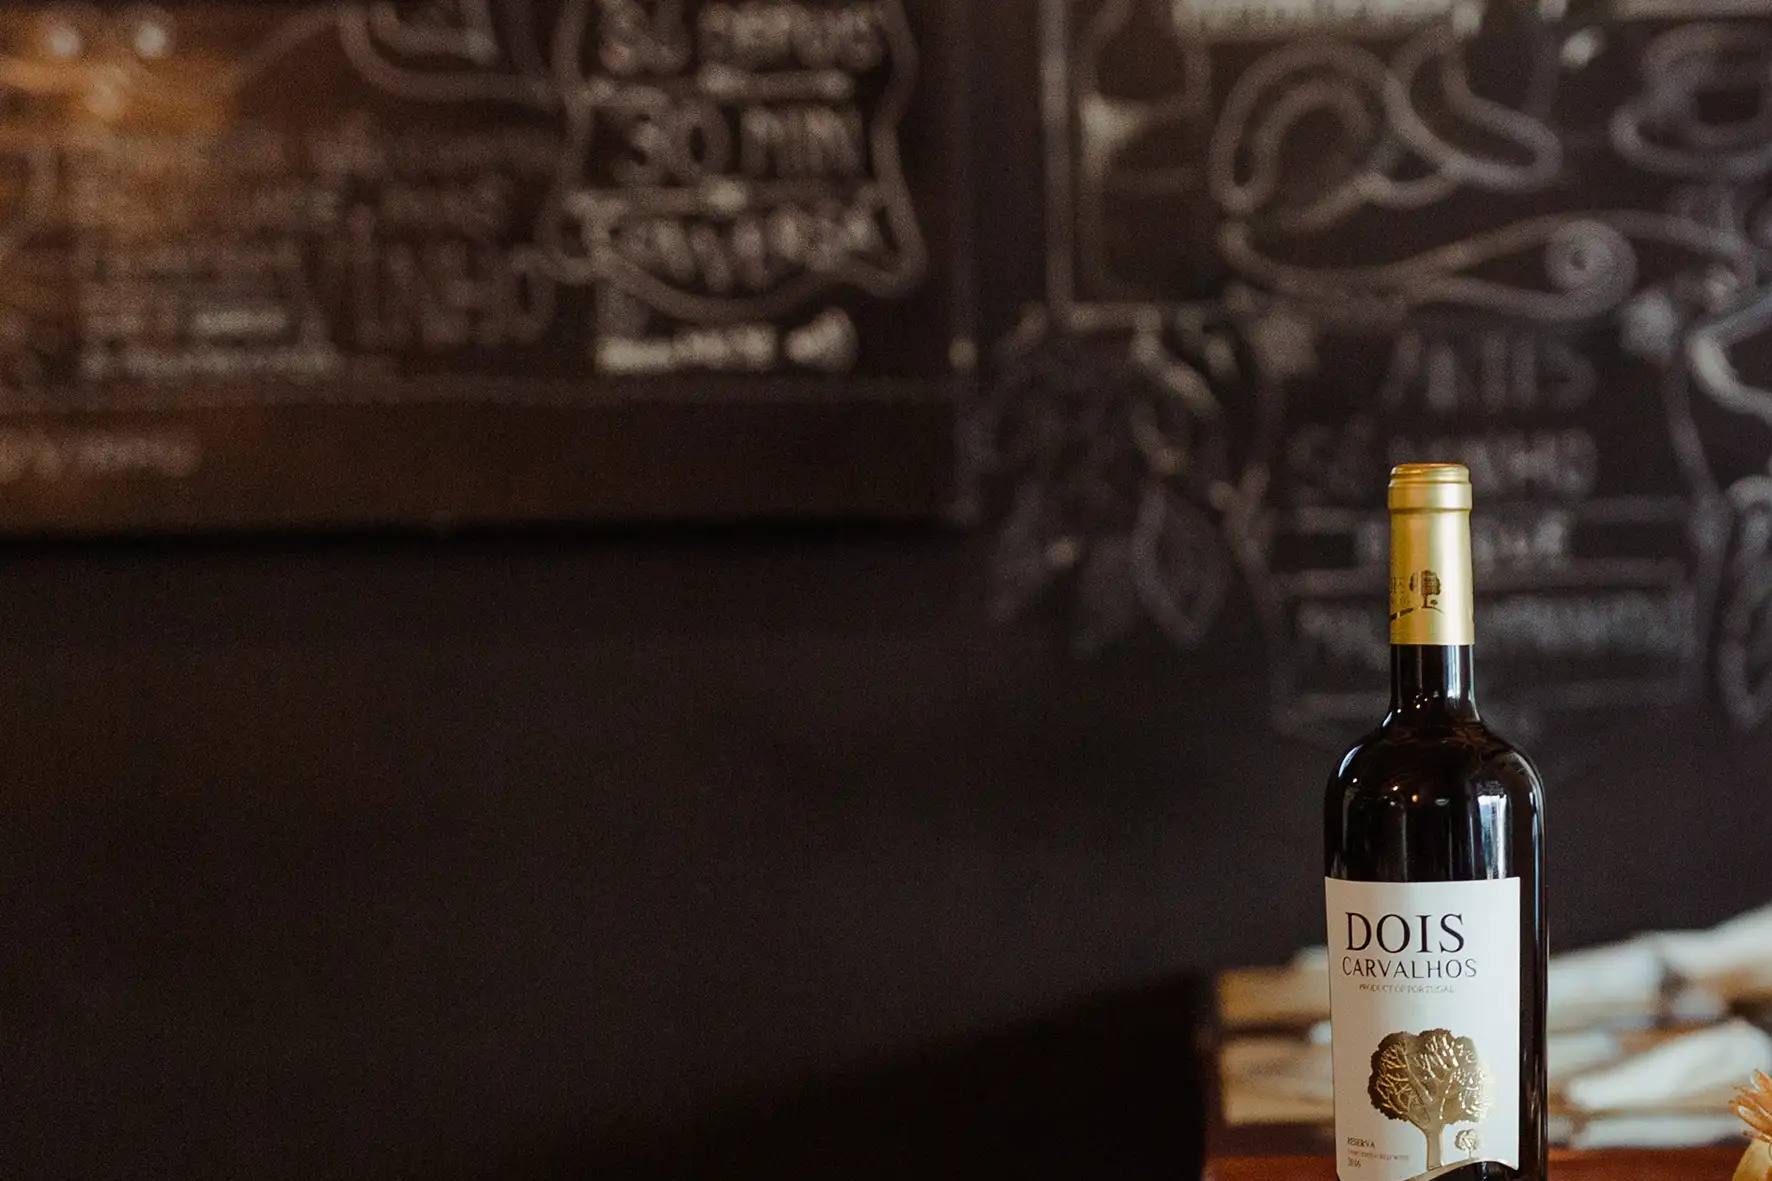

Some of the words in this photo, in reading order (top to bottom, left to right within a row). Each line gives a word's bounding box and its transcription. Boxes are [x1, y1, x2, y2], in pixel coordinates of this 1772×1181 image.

[612, 94, 730, 184] 30
[1345, 911, 1465, 953] DOIS
[1342, 956, 1477, 979] CARVALHOS
